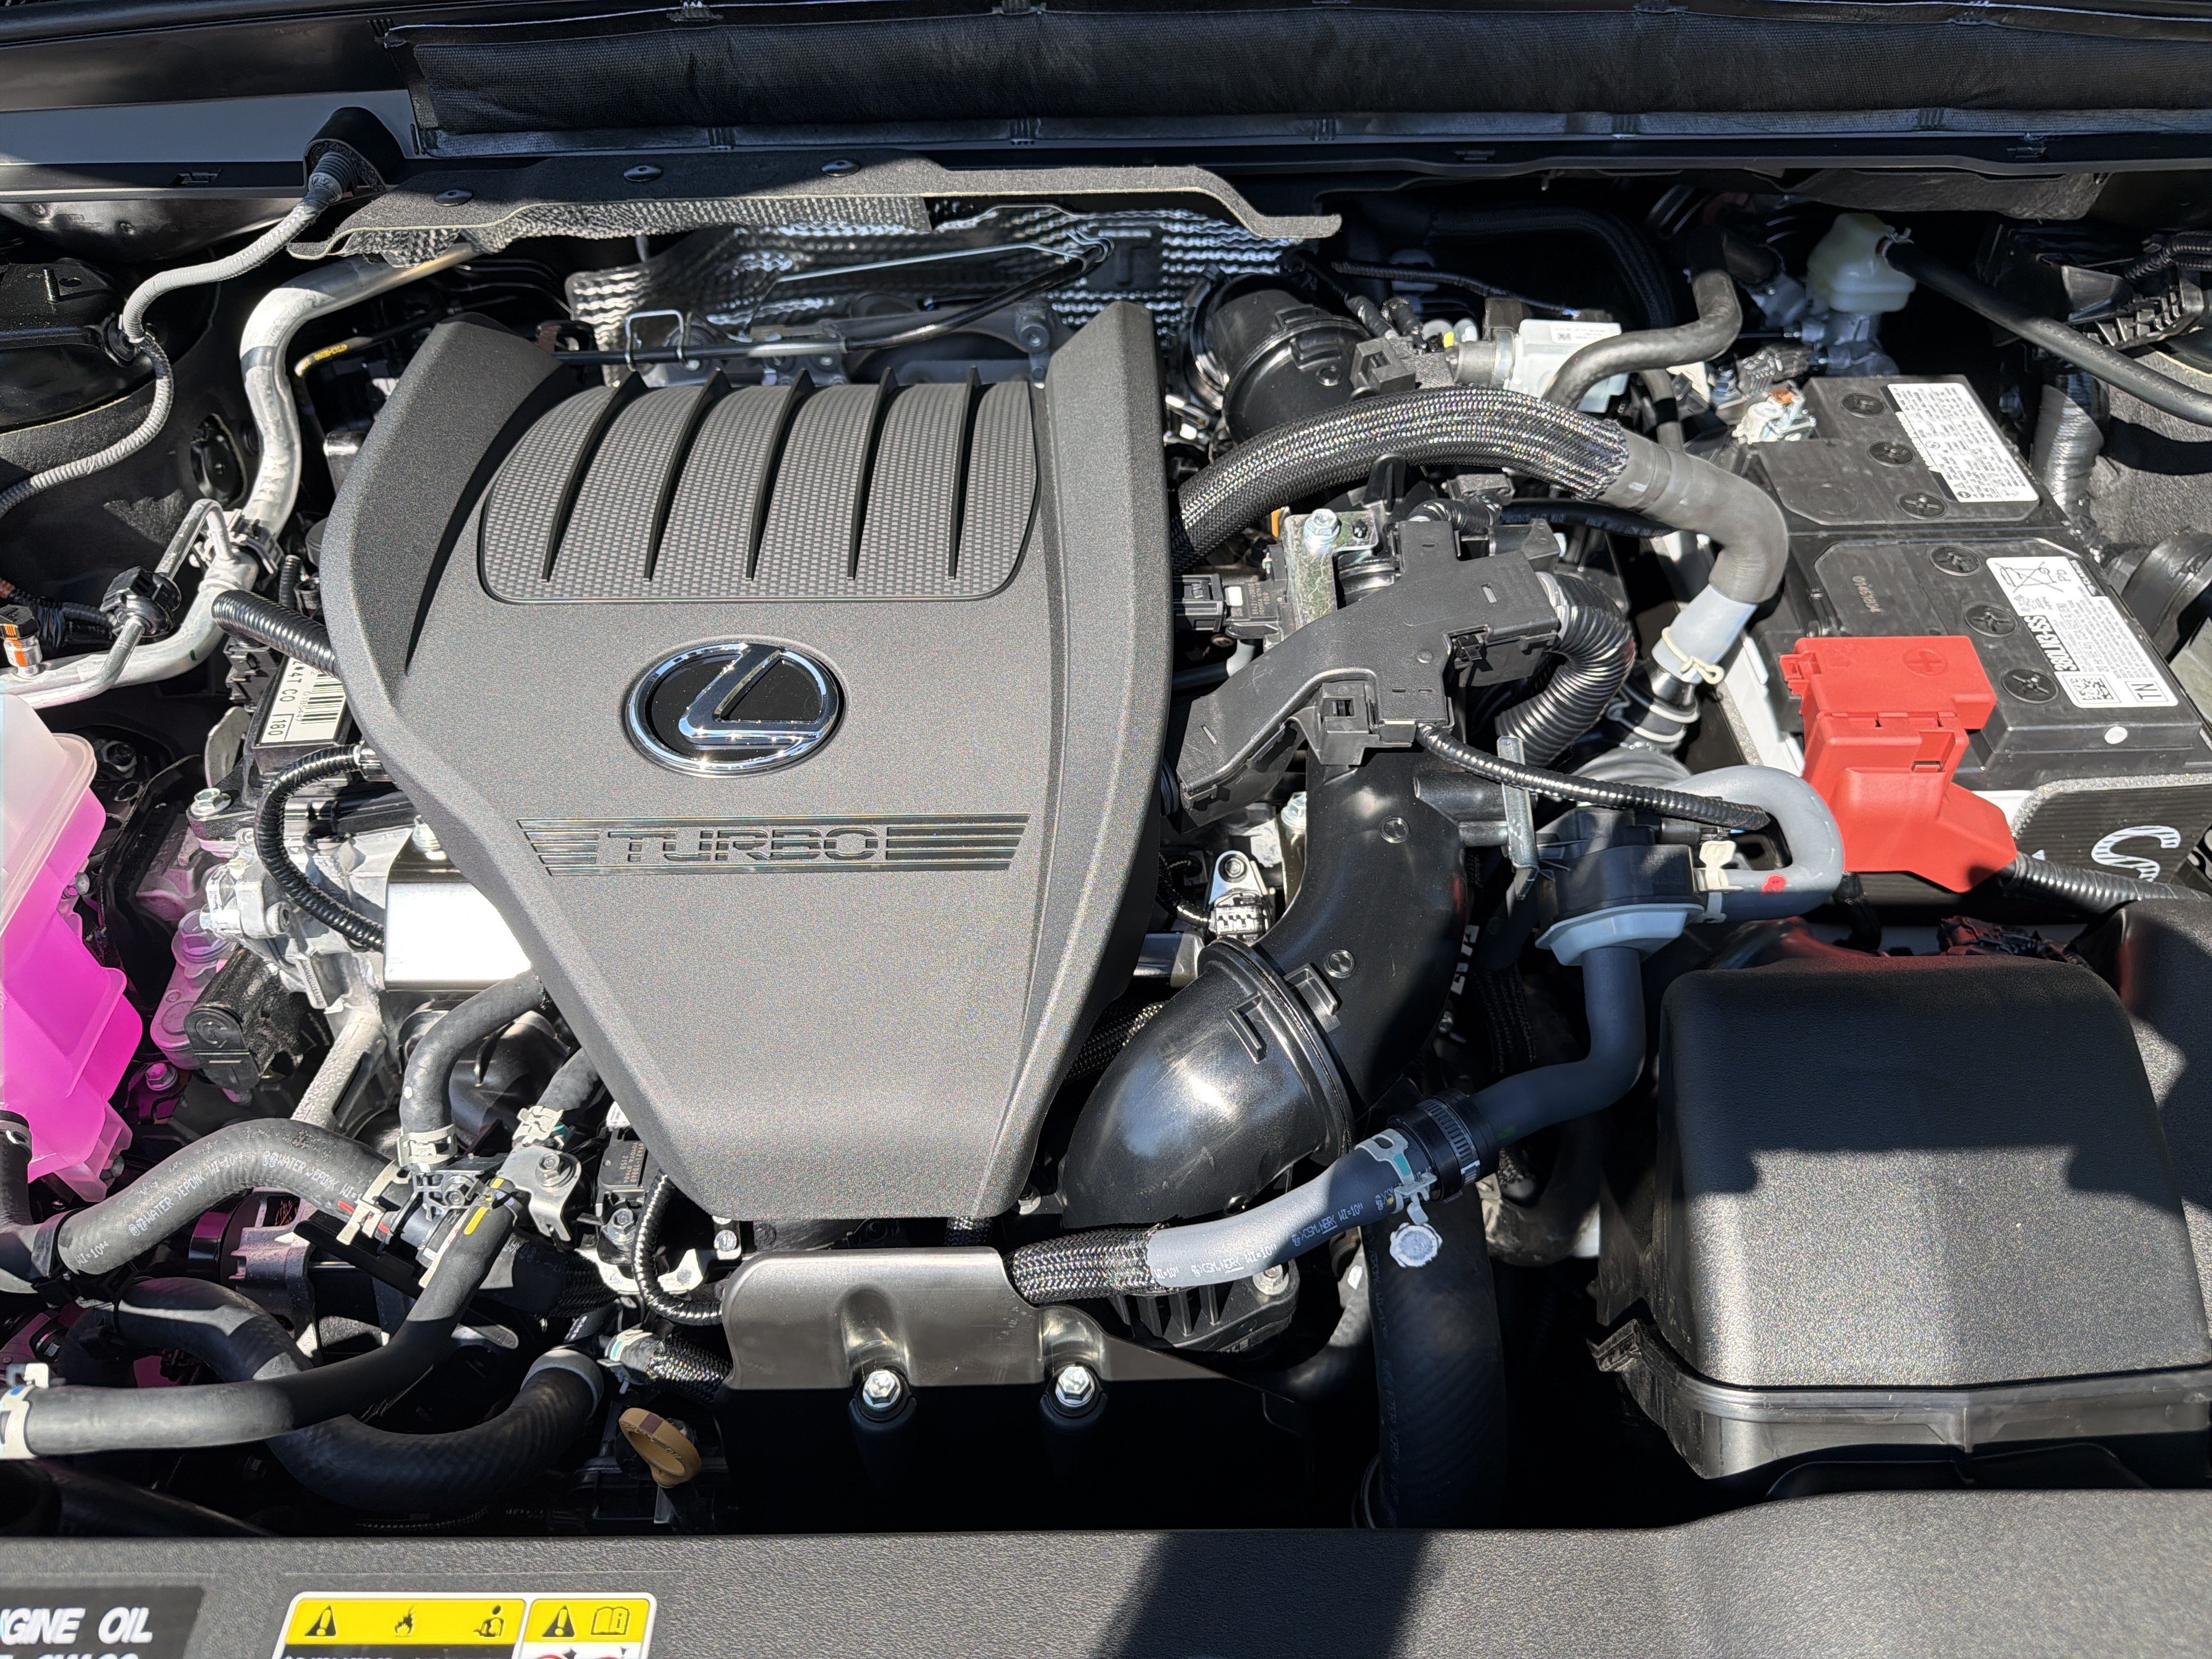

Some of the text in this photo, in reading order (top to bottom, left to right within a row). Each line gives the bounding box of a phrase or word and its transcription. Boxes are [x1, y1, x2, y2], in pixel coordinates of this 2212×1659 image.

[1257, 599, 1265, 616] TOYOTA
[2024, 616, 2078, 672] 380LN3-ISS
[2131, 682, 2160, 701] TN
[267, 719, 287, 736] 180
[607, 828, 878, 862] TURBO
[628, 1142, 638, 1163] TOYOTA
[144, 1196, 176, 1224] WATER
[277, 1152, 307, 1174] WATER
[98, 1606, 154, 1645] OIL
